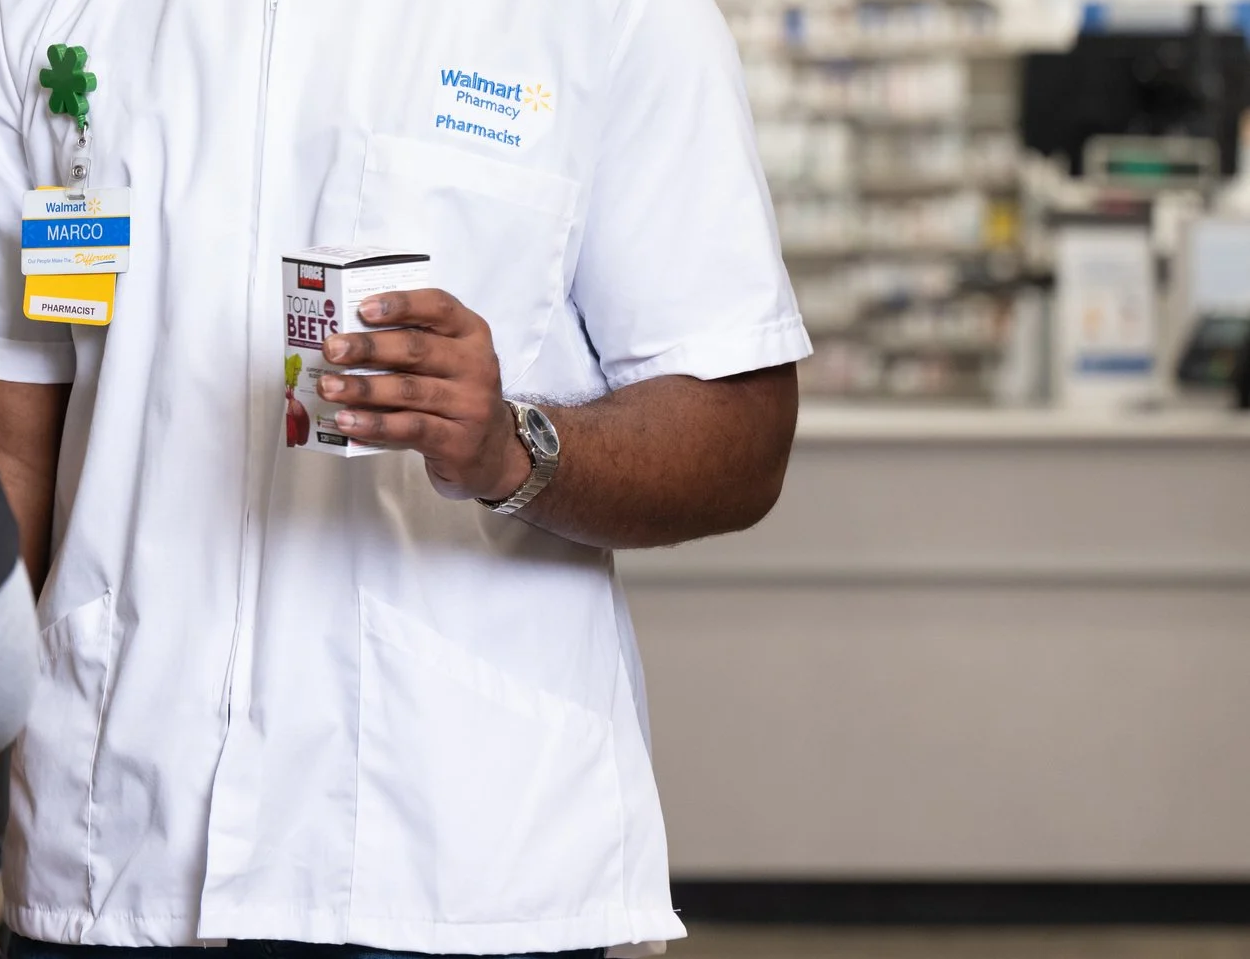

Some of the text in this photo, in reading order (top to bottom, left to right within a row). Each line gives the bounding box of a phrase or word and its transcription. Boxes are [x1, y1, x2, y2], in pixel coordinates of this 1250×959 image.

[440, 69, 523, 102] Walmart
[456, 90, 520, 120] Pharmacy
[436, 114, 522, 148] Pharmacist
[46, 201, 86, 213] Walmart
[47, 223, 103, 240] MARCO
[75, 252, 118, 266] Difference
[42, 303, 96, 316] PHARMACIST
[286, 294, 324, 317] TOTAL
[287, 313, 339, 342] BEETS
